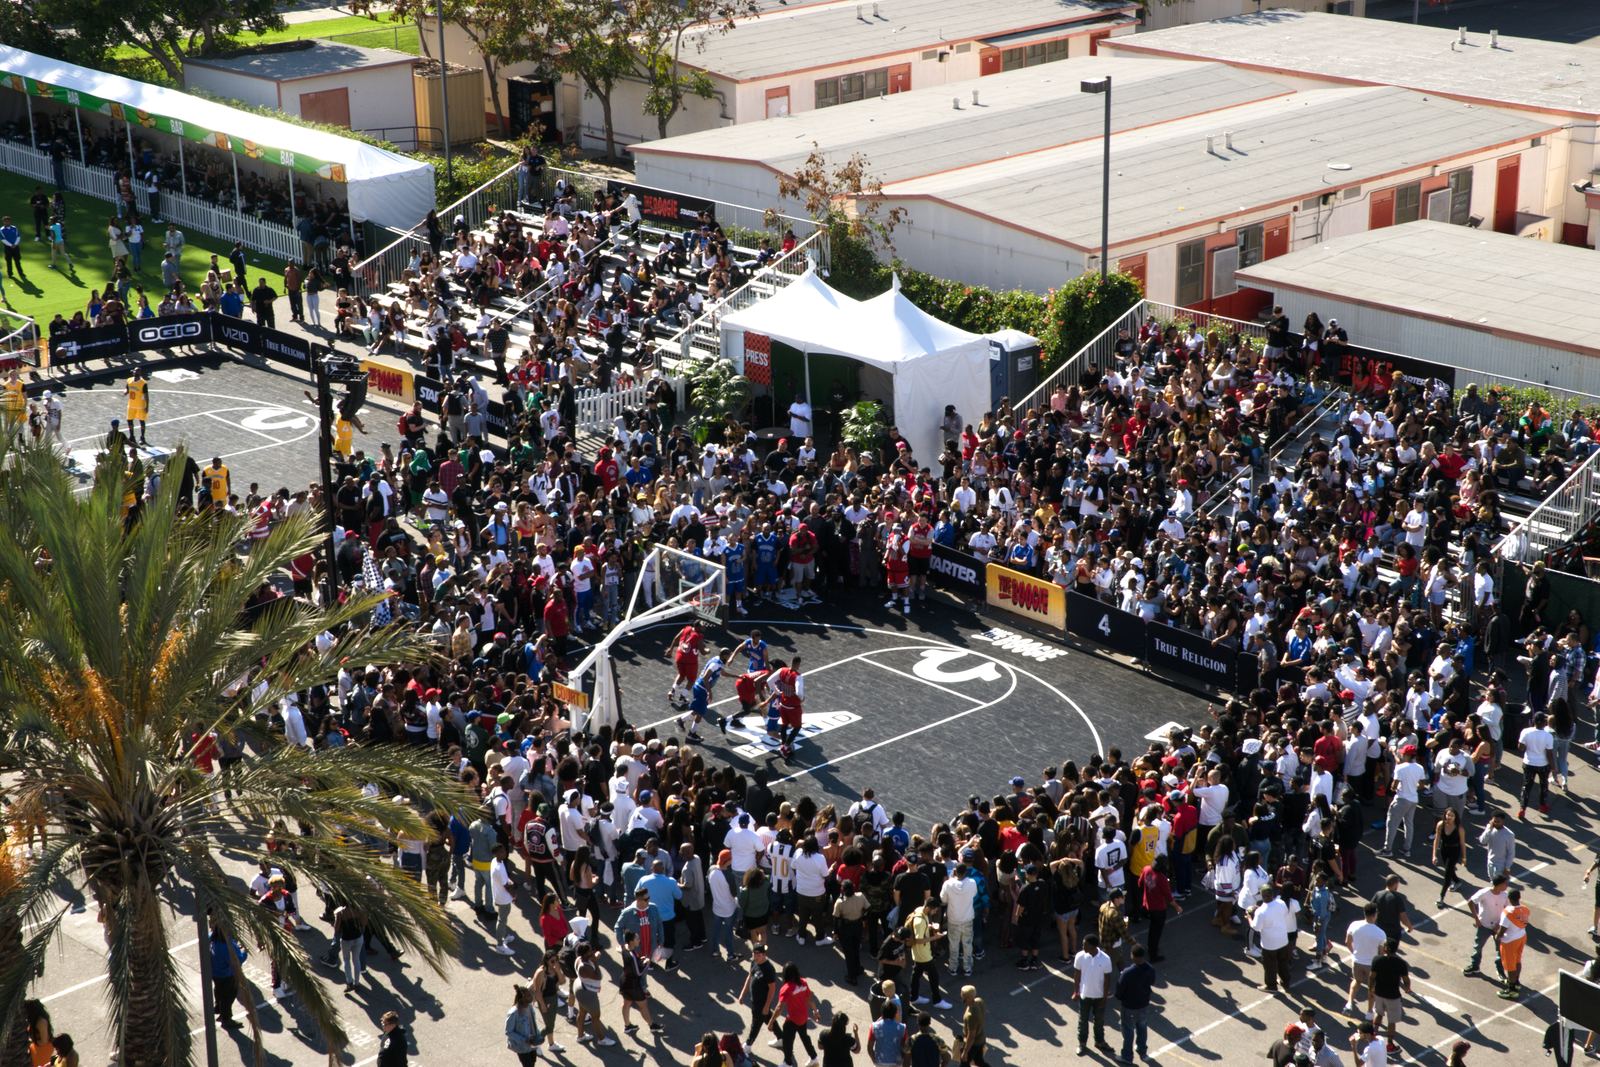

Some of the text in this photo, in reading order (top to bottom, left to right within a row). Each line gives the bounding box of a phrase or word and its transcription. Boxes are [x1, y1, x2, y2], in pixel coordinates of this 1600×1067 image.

[170, 119, 184, 136] BAR
[280, 150, 295, 166] BAR
[138, 321, 201, 343] OGIO
[222, 325, 249, 344] VIZIO
[266, 338, 306, 361] TRUE RELIGION
[745, 348, 769, 367] PRESS
[930, 554, 977, 585] TARTER
[998, 574, 1049, 616] THE BOOGIE
[1098, 613, 1111, 637] 4
[1154, 637, 1227, 674] TRUE RELIGION
[555, 683, 580, 706] COURT
[1145, 840, 1155, 852] 14
[772, 856, 789, 878] 10
